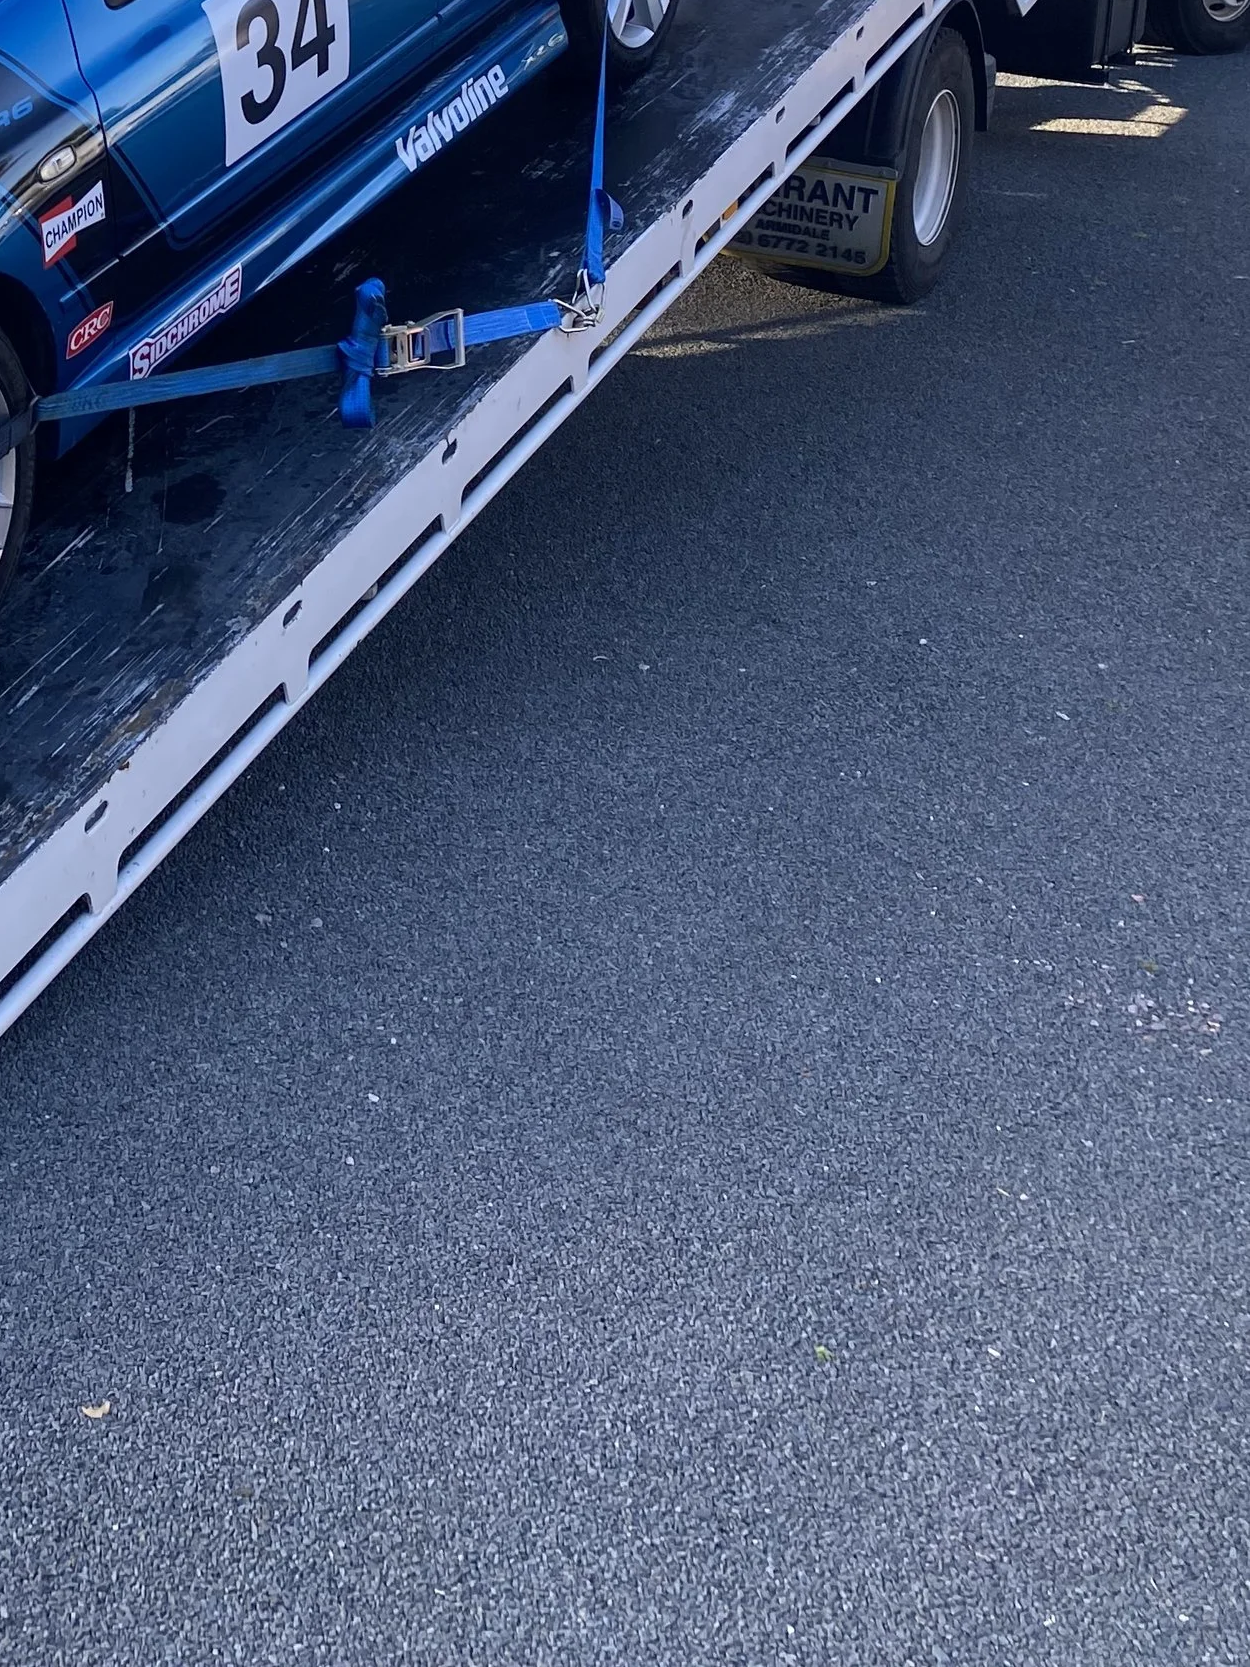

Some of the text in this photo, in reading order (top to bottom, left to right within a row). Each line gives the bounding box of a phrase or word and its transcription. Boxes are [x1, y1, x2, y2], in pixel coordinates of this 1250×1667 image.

[395, 64, 509, 173] Valvoline
[774, 174, 879, 214] RANT
[45, 193, 104, 249] CHAMPION
[754, 218, 830, 241] ARMIDALE
[756, 200, 859, 232] CHINERY
[757, 233, 810, 254] 6772
[70, 305, 111, 351] CRC
[133, 269, 240, 380] SIDCHROME
